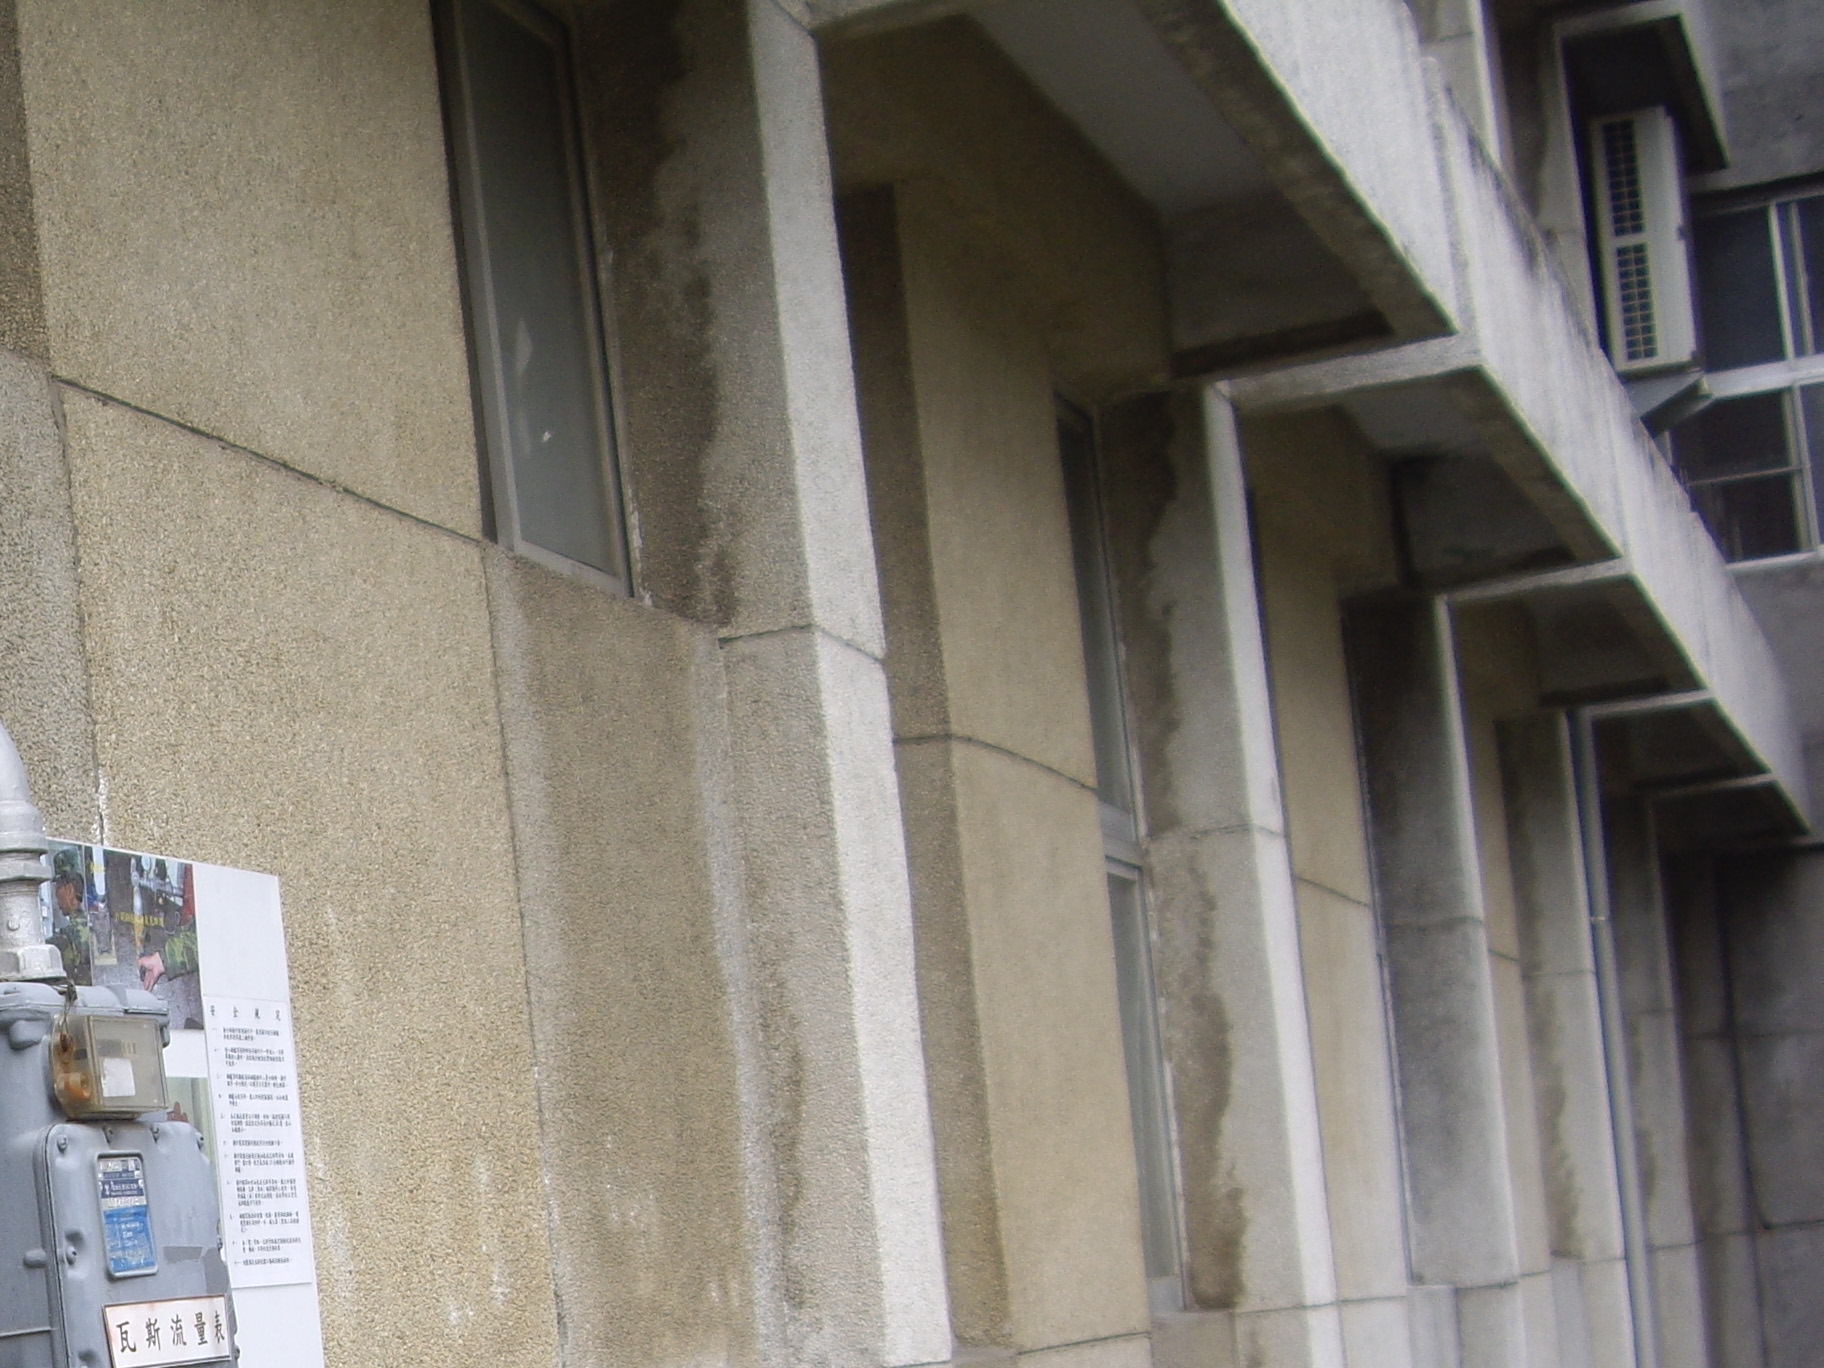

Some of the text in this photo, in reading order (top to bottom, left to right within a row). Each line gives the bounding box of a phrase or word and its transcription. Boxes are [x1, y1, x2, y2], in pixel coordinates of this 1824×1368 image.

[115, 1310, 226, 1353] 瓦斯流量表
